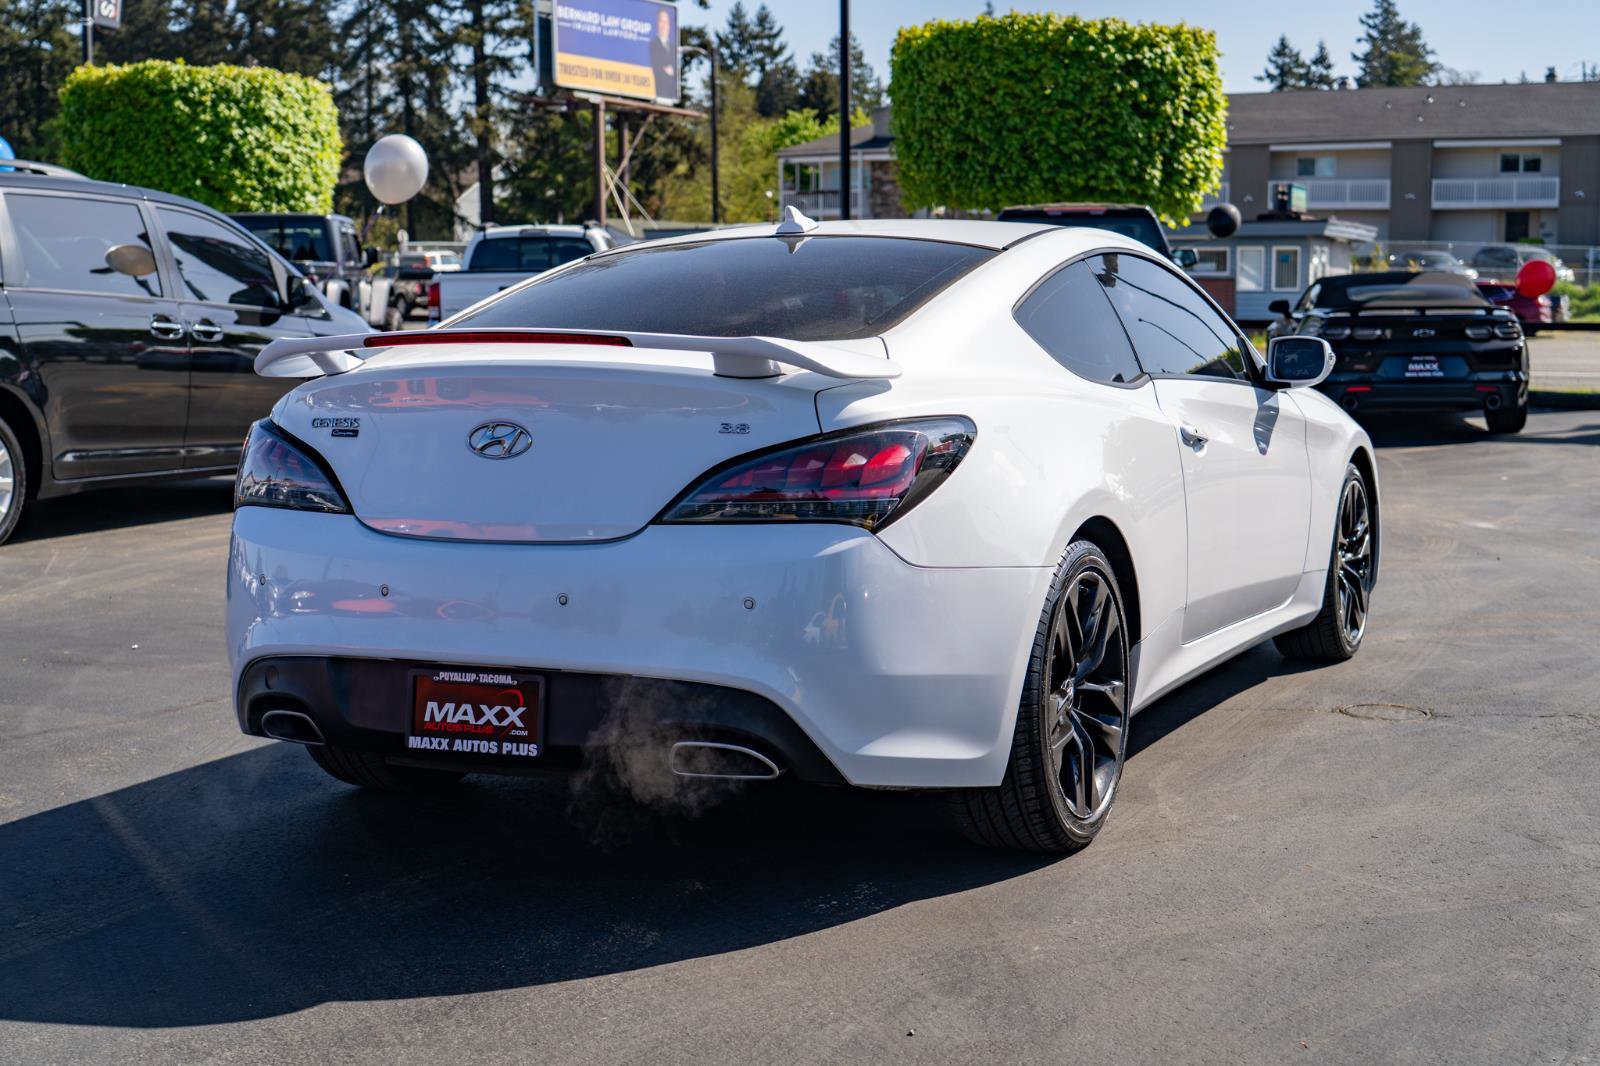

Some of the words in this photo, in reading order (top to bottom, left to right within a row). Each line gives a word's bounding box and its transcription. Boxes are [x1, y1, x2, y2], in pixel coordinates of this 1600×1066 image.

[558, 5, 600, 25] BERNARD
[601, 14, 620, 27] LAW
[620, 17, 652, 34] GROUP
[312, 417, 360, 428] GENESIS
[719, 423, 751, 434] 3.8
[424, 701, 527, 728] MAXX
[408, 736, 450, 751] MAXX
[453, 738, 498, 754] AUTOS
[502, 742, 538, 757] PLUS
